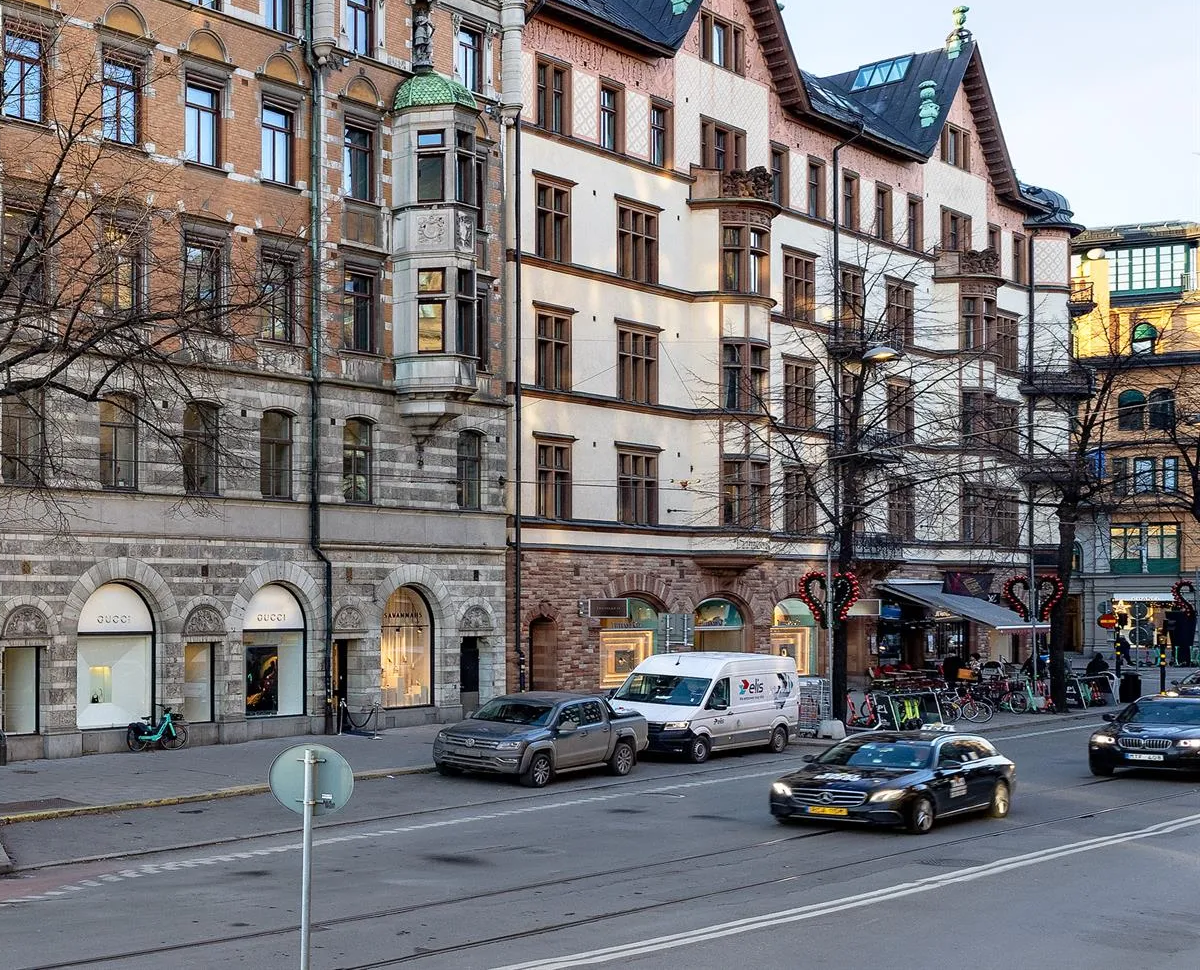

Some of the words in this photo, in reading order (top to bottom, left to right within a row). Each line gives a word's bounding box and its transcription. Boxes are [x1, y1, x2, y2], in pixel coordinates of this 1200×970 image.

[96, 615, 131, 624] GUCCI
[256, 613, 286, 622] GUCCI
[749, 678, 764, 694] elis
